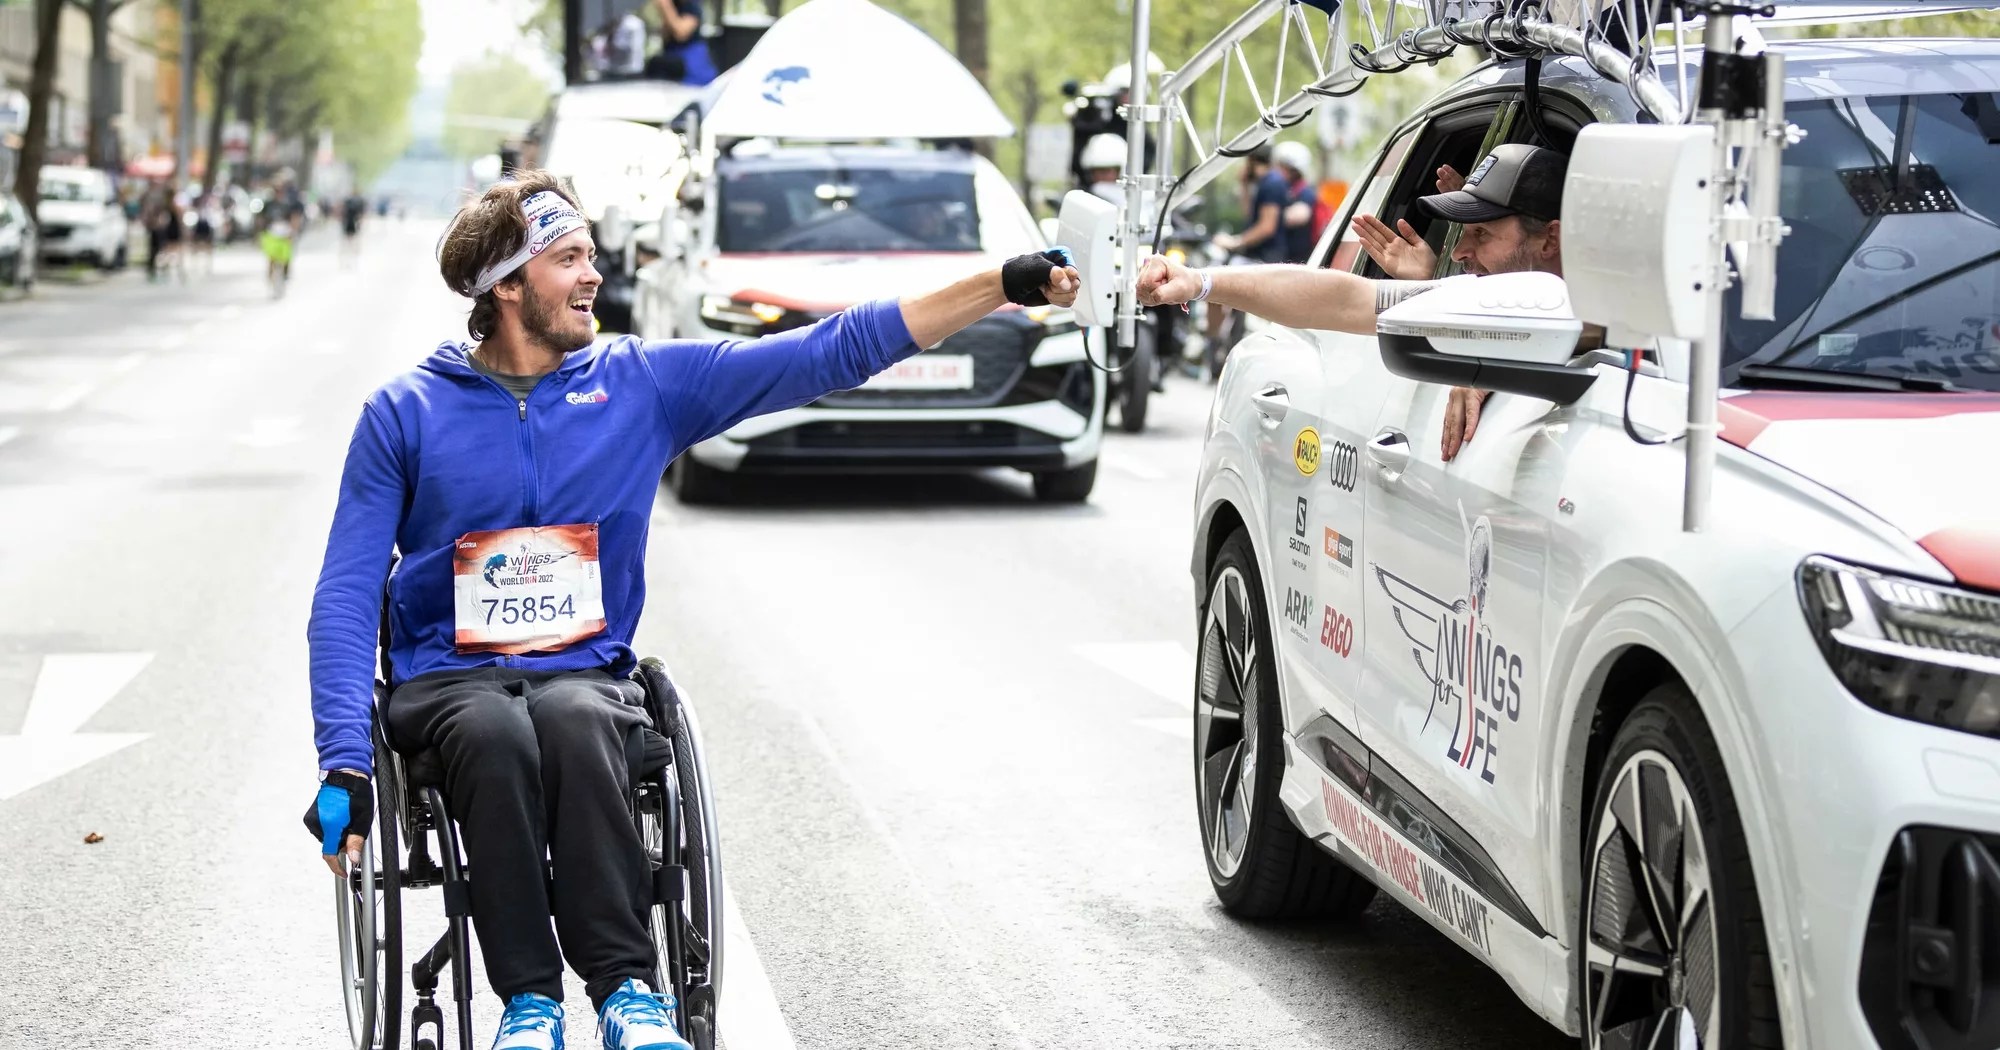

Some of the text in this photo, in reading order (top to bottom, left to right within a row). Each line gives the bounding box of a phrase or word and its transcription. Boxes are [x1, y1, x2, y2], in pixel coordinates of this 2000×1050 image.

[1301, 440, 1319, 465] RAUCH
[510, 553, 552, 567] WINGS
[516, 564, 540, 576] LIFE
[538, 574, 554, 583] 2022
[481, 594, 576, 625] 75854
[1284, 586, 1308, 630] ARA
[1320, 604, 1353, 658] ERGO
[1420, 618, 1460, 736] for
[1442, 612, 1522, 723] WINGS
[1447, 698, 1498, 785] LIFE
[1321, 776, 1492, 956] RUNNING FOR THOSE WHO CAN'T
